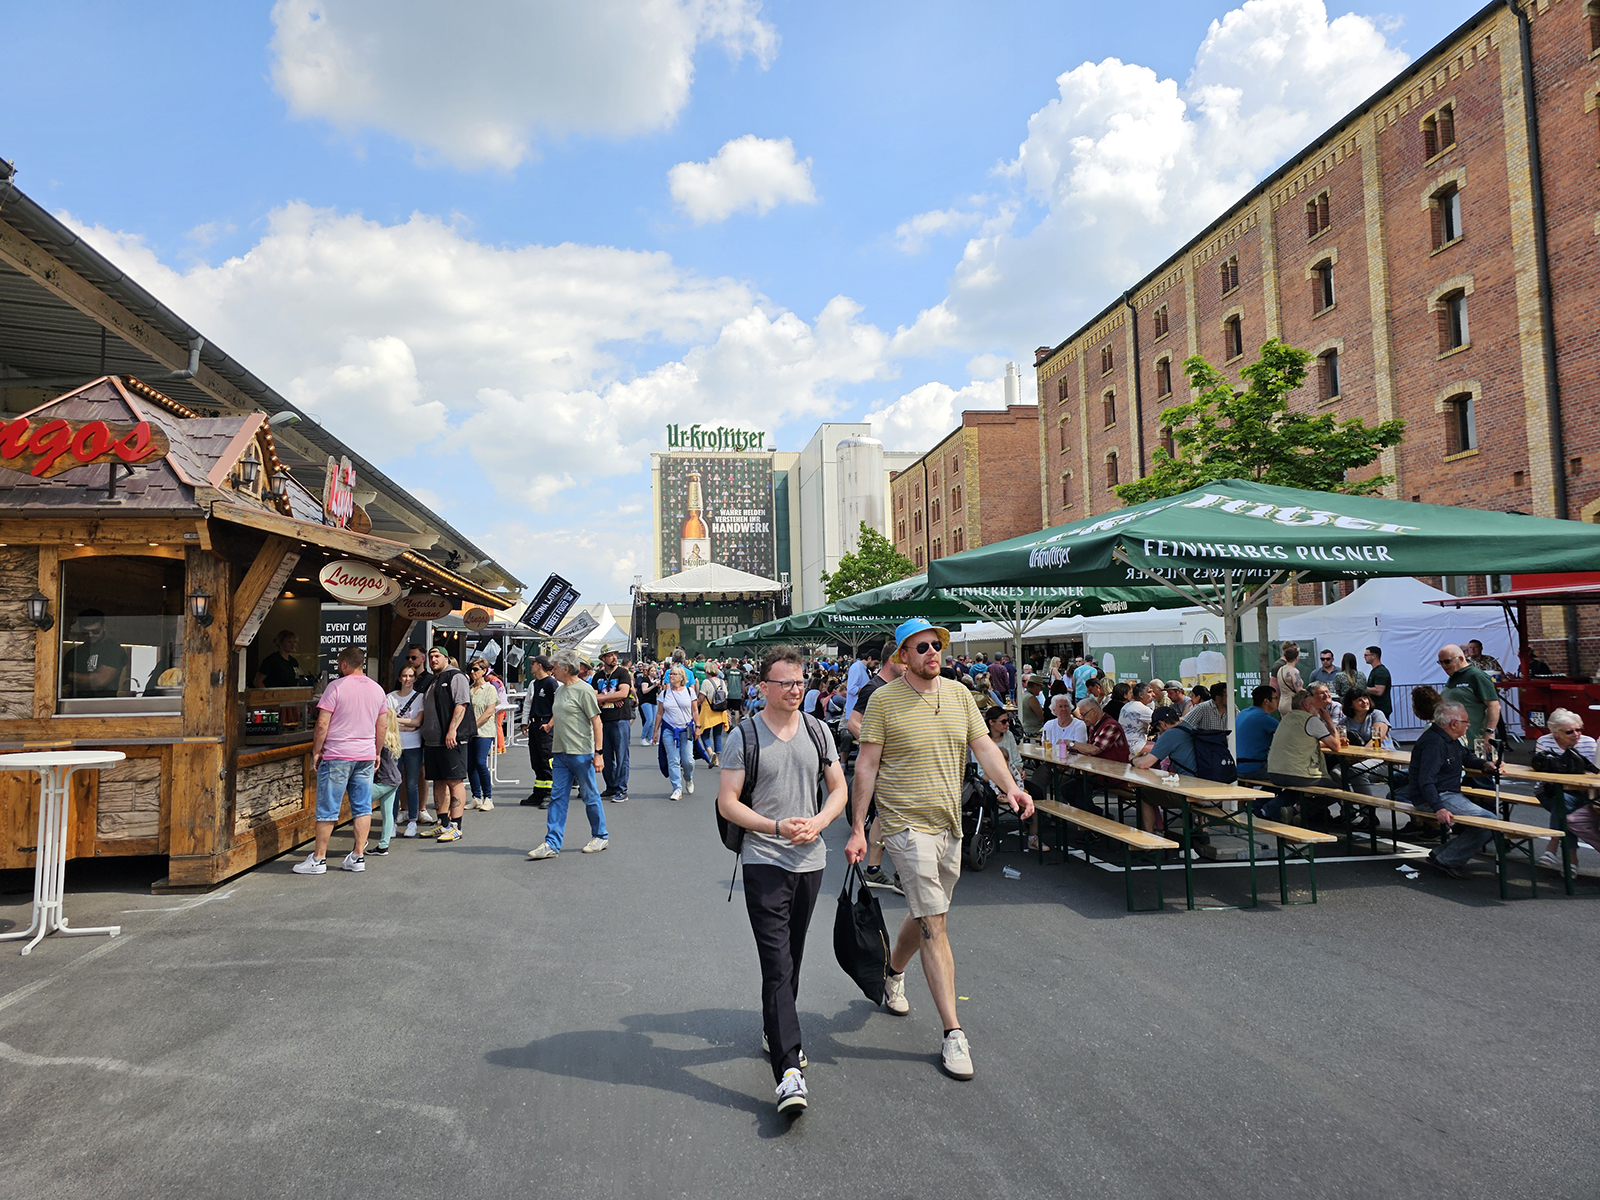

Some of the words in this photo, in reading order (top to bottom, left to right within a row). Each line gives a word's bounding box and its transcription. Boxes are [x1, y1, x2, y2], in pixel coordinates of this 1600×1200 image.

[712, 522, 770, 533] HANDWERK
[1143, 539, 1289, 560] FEINHERBES
[1296, 545, 1395, 562] PILSNER
[323, 566, 385, 595] Langos
[942, 586, 1024, 597] FEINHERBES
[1030, 586, 1085, 597] PILSNER
[403, 598, 437, 609] Nutella
[438, 600, 446, 608] &
[407, 609, 441, 618] Banane
[544, 614, 561, 632] STREET
[556, 600, 570, 617] FOOD
[463, 613, 489, 628] Langos
[683, 617, 710, 625] WAHRE
[711, 616, 739, 624] HELDEN
[326, 623, 350, 631] EVENT
